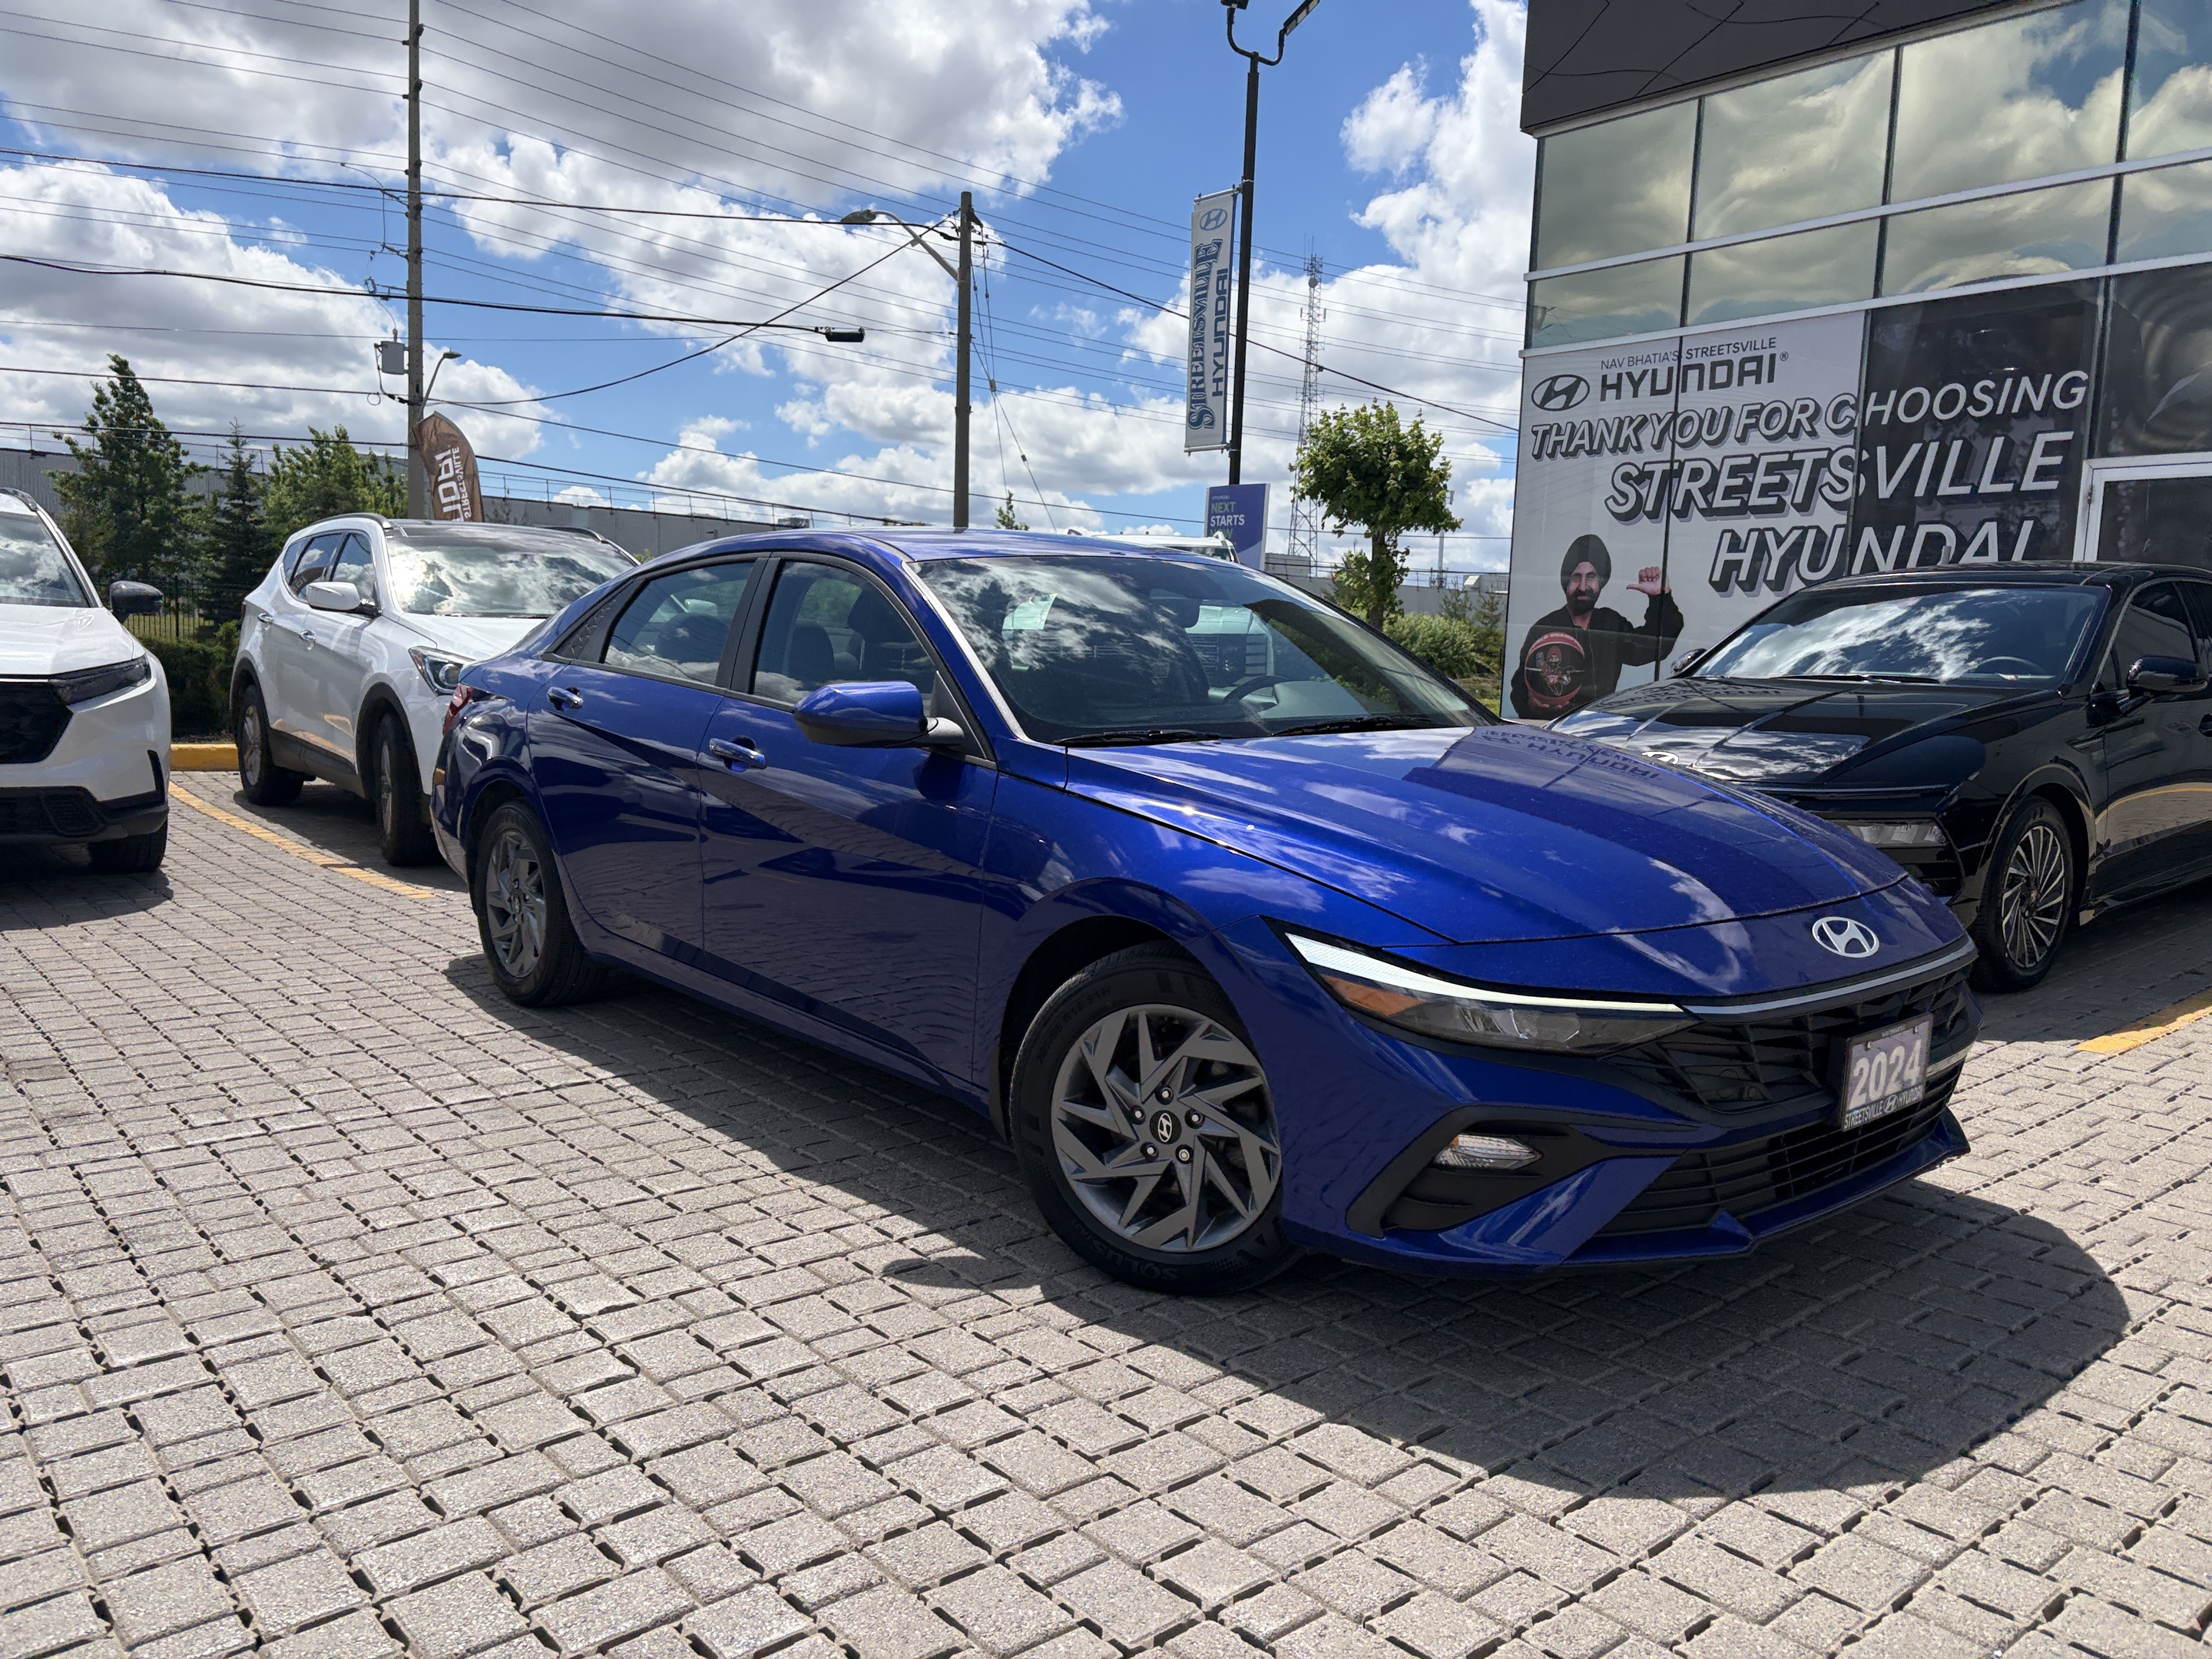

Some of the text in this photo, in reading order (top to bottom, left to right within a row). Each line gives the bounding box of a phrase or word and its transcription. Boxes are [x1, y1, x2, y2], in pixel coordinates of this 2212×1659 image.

[1188, 238, 1224, 429] STREETSVILLE
[1211, 268, 1229, 397] HYUNDAI
[1601, 337, 1777, 370] NAV BHATIA'S STREETSVILLE
[1531, 369, 2089, 461] THANK YOU FOR CHOOSING
[1604, 430, 2075, 524] STREETSVILLE
[1210, 514, 1246, 528] STARTS
[1210, 528, 1233, 540] NW
[1211, 502, 1237, 514] NEXT
[1709, 516, 2043, 594] HYUNDAI
[1061, 1001, 1085, 1024] R16
[1086, 984, 1112, 1005] 91H
[1849, 1039, 1922, 1111] 2024
[1844, 1101, 1883, 1129] STREETSVILLE
